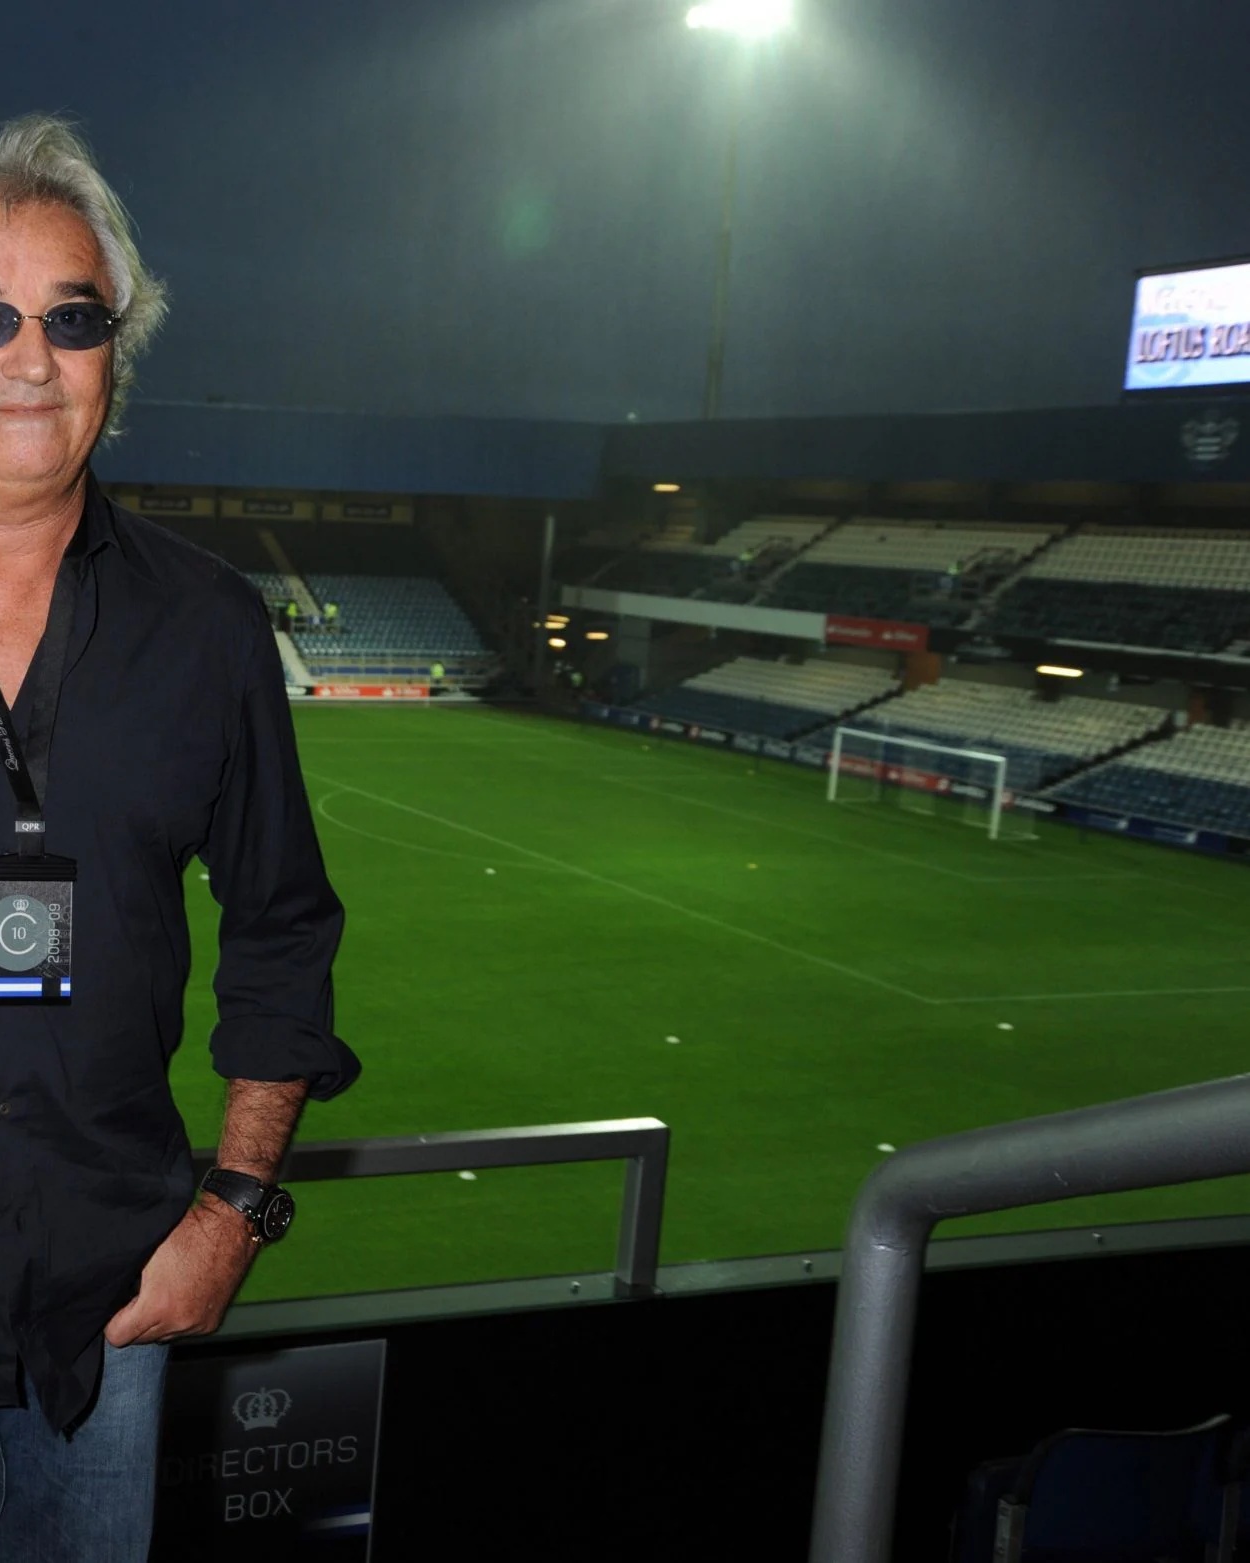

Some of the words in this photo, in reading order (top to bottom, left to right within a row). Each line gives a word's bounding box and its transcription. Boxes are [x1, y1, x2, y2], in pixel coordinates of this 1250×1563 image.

[21, 823, 40, 832] QPR
[11, 926, 27, 940] 10
[48, 903, 61, 963] 2008-09
[224, 1487, 294, 1523] BOX
